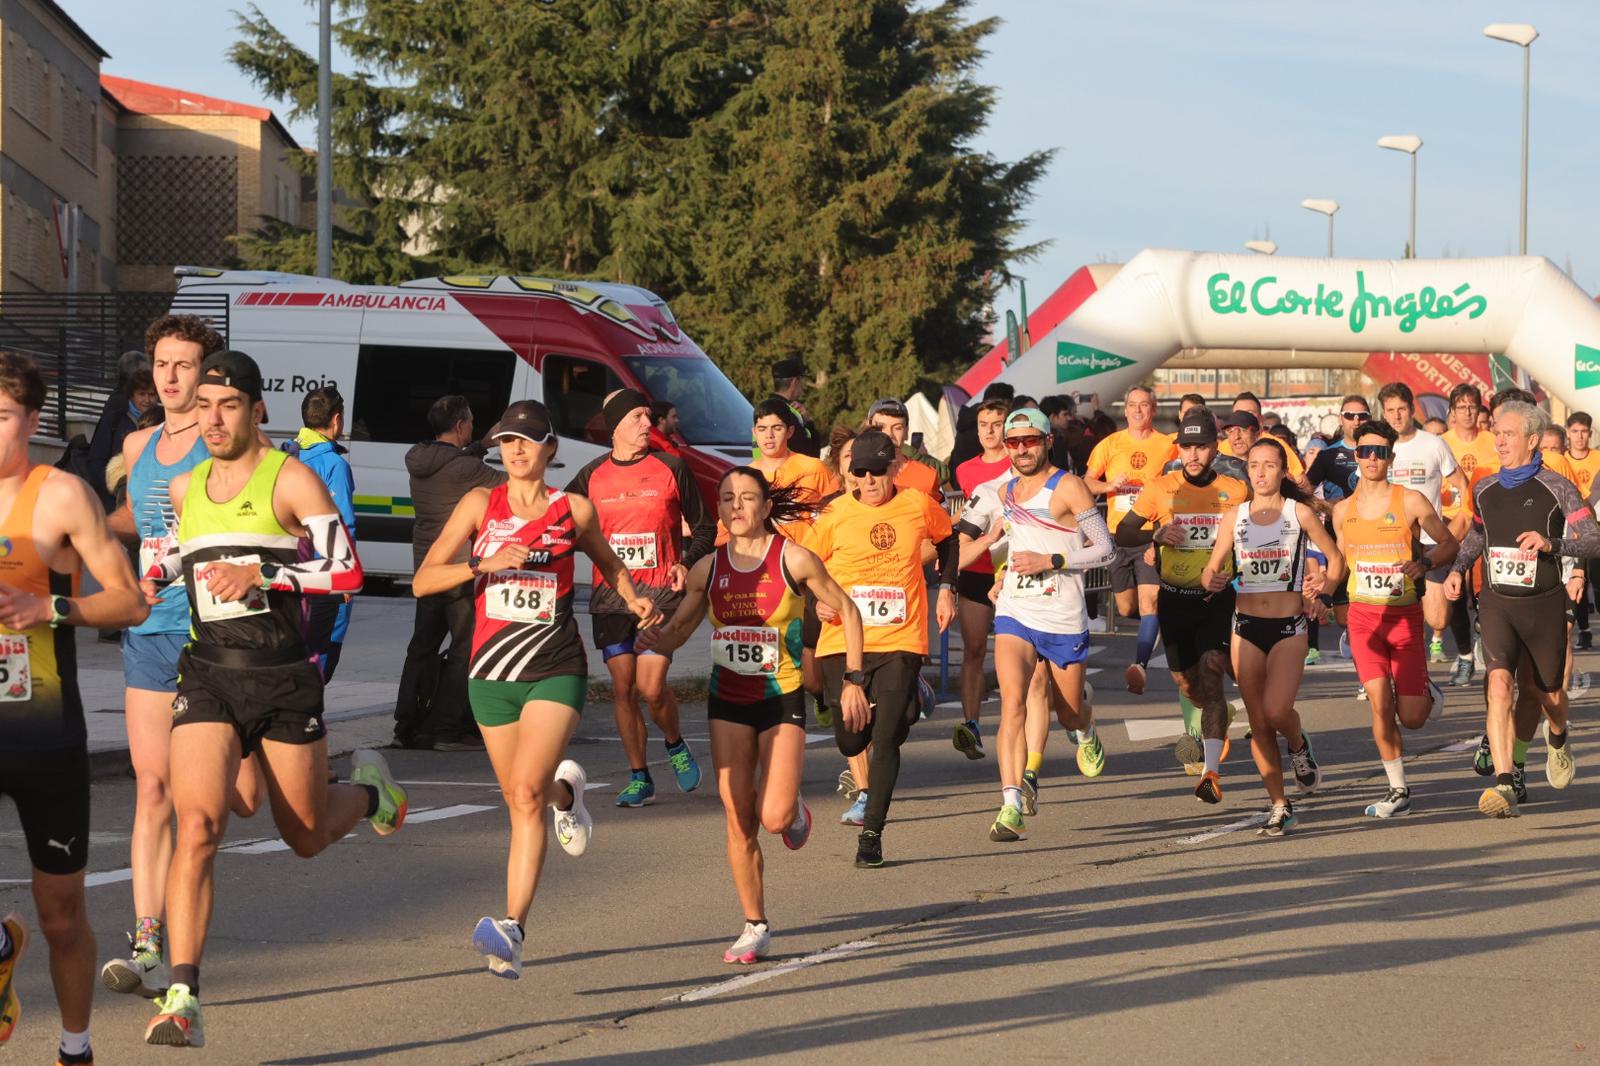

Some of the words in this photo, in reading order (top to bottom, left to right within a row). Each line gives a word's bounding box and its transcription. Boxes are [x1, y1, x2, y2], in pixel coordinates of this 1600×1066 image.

[321, 292, 447, 311] AMBULANCIA
[1207, 272, 1247, 314] El
[1250, 276, 1344, 316] Corte
[1349, 270, 1488, 334] Inglés
[1057, 354, 1067, 366] El
[1067, 354, 1090, 366] Corte
[1089, 352, 1122, 370] Inglés
[1575, 359, 1586, 372] El
[261, 376, 285, 392] uz
[1436, 352, 1496, 404] UESTRO
[610, 536, 655, 546] bedunia
[1189, 526, 1209, 541] 23
[616, 546, 645, 561] 591
[866, 552, 901, 565] UPSA
[1240, 548, 1290, 560] bedunia
[1250, 560, 1281, 576] 307
[1495, 560, 1526, 577] 398
[488, 571, 556, 590] bedunia
[1364, 574, 1394, 589] 134
[500, 587, 542, 610] 168
[851, 588, 905, 600] bedunia
[731, 601, 757, 610] VINO
[867, 600, 889, 617] 16
[722, 610, 735, 619] DE
[739, 608, 767, 618] TORO
[712, 628, 777, 643] bedunia
[725, 643, 764, 663] 158
